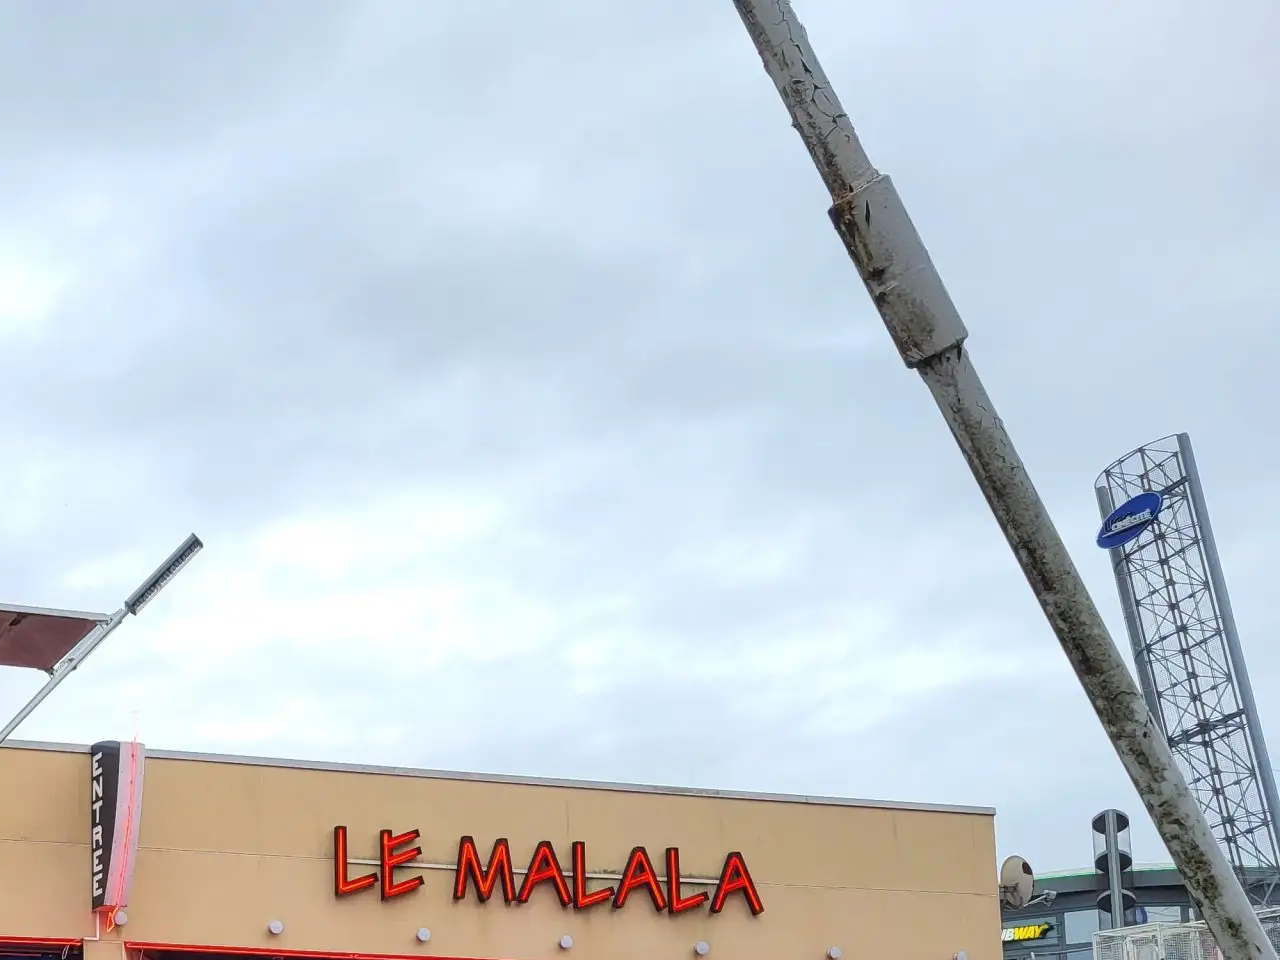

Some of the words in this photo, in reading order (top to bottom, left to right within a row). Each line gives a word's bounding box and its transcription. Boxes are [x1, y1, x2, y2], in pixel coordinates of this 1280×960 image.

[92, 751, 103, 898] ENTREE
[334, 825, 424, 901] LE
[453, 836, 764, 915] MALALA
